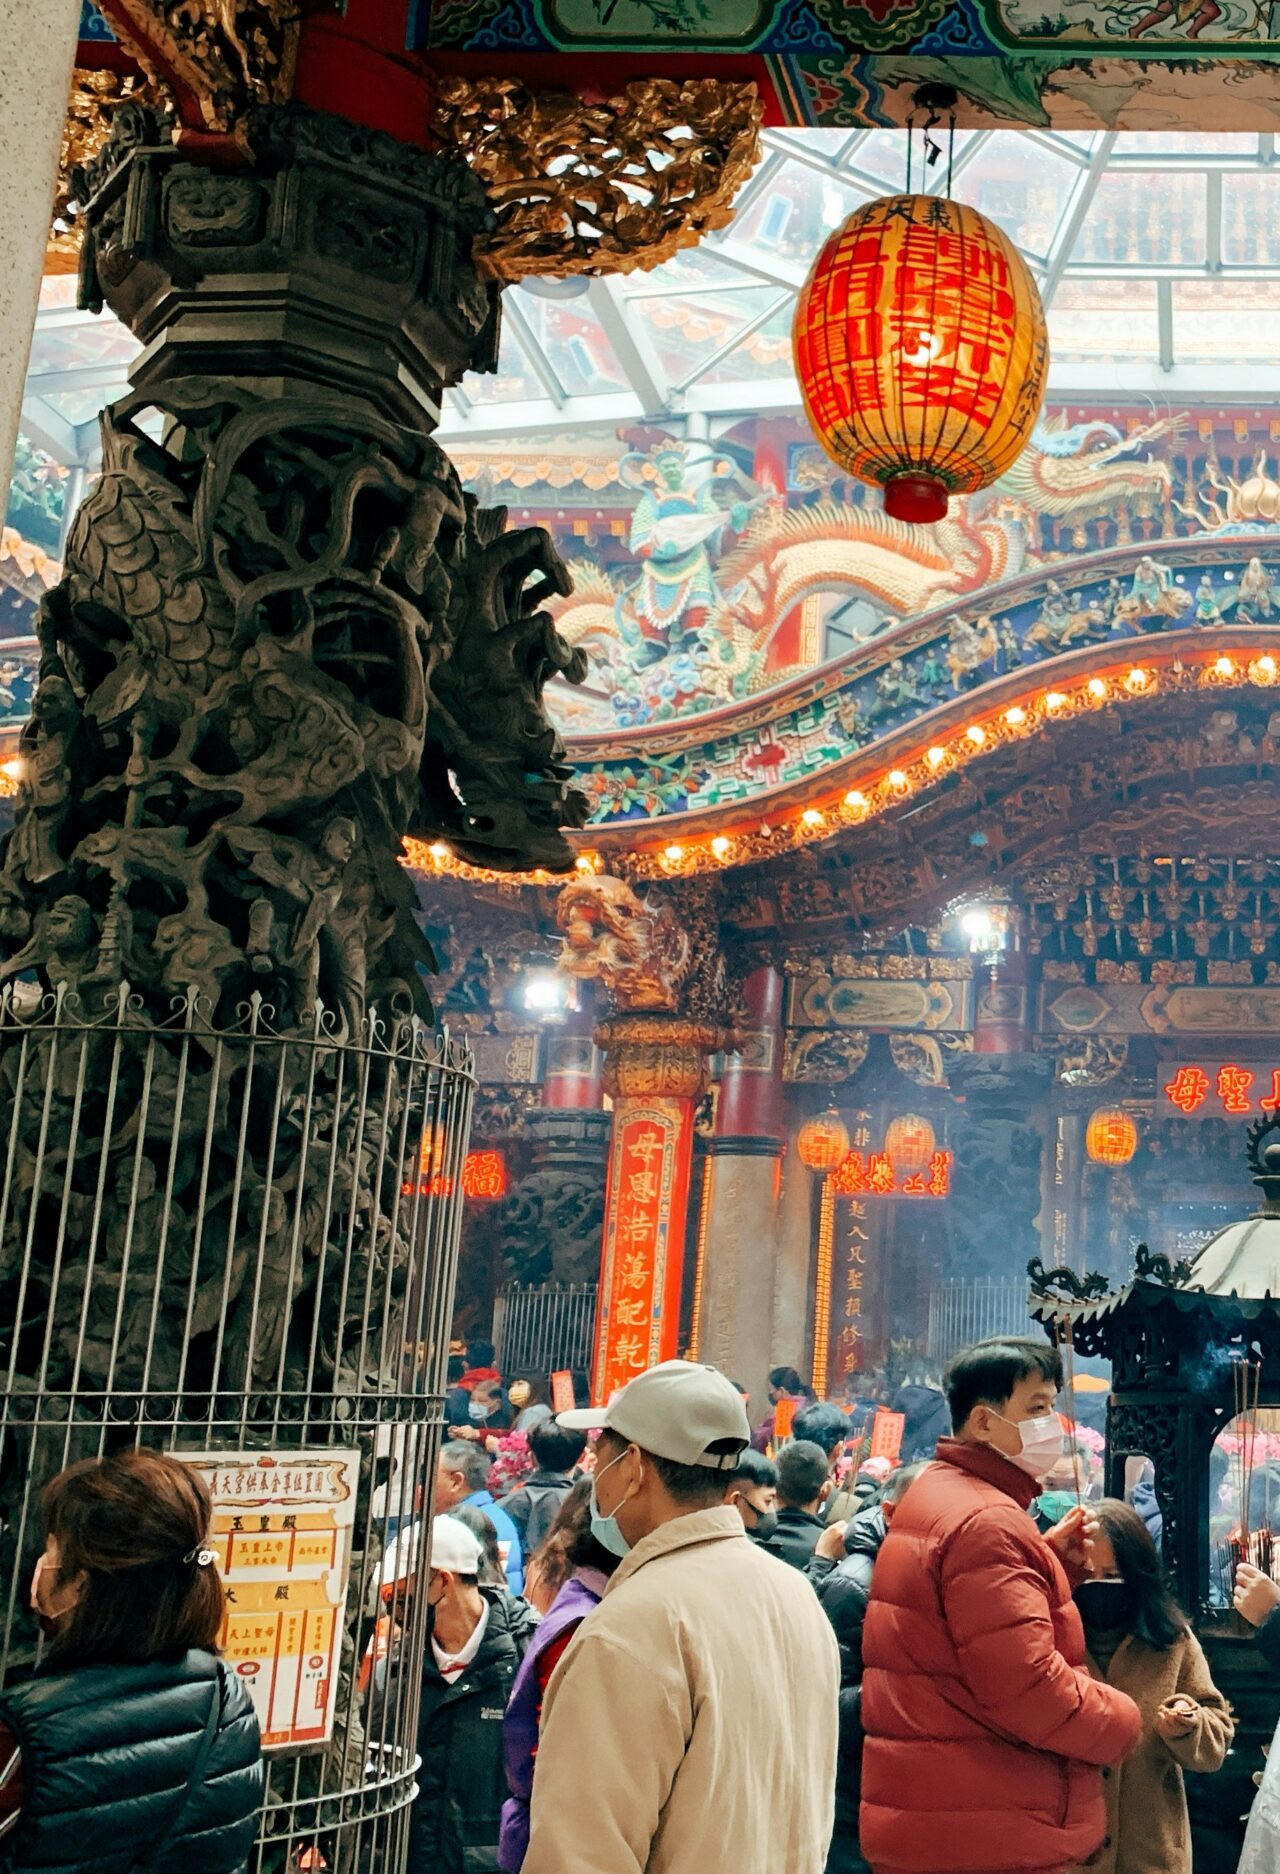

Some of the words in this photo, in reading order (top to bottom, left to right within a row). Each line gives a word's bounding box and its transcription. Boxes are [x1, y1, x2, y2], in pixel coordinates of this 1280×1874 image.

[611, 1131, 664, 1394] 母恩浩蕩配乾
[230, 1515, 297, 1532] 玉皇殿
